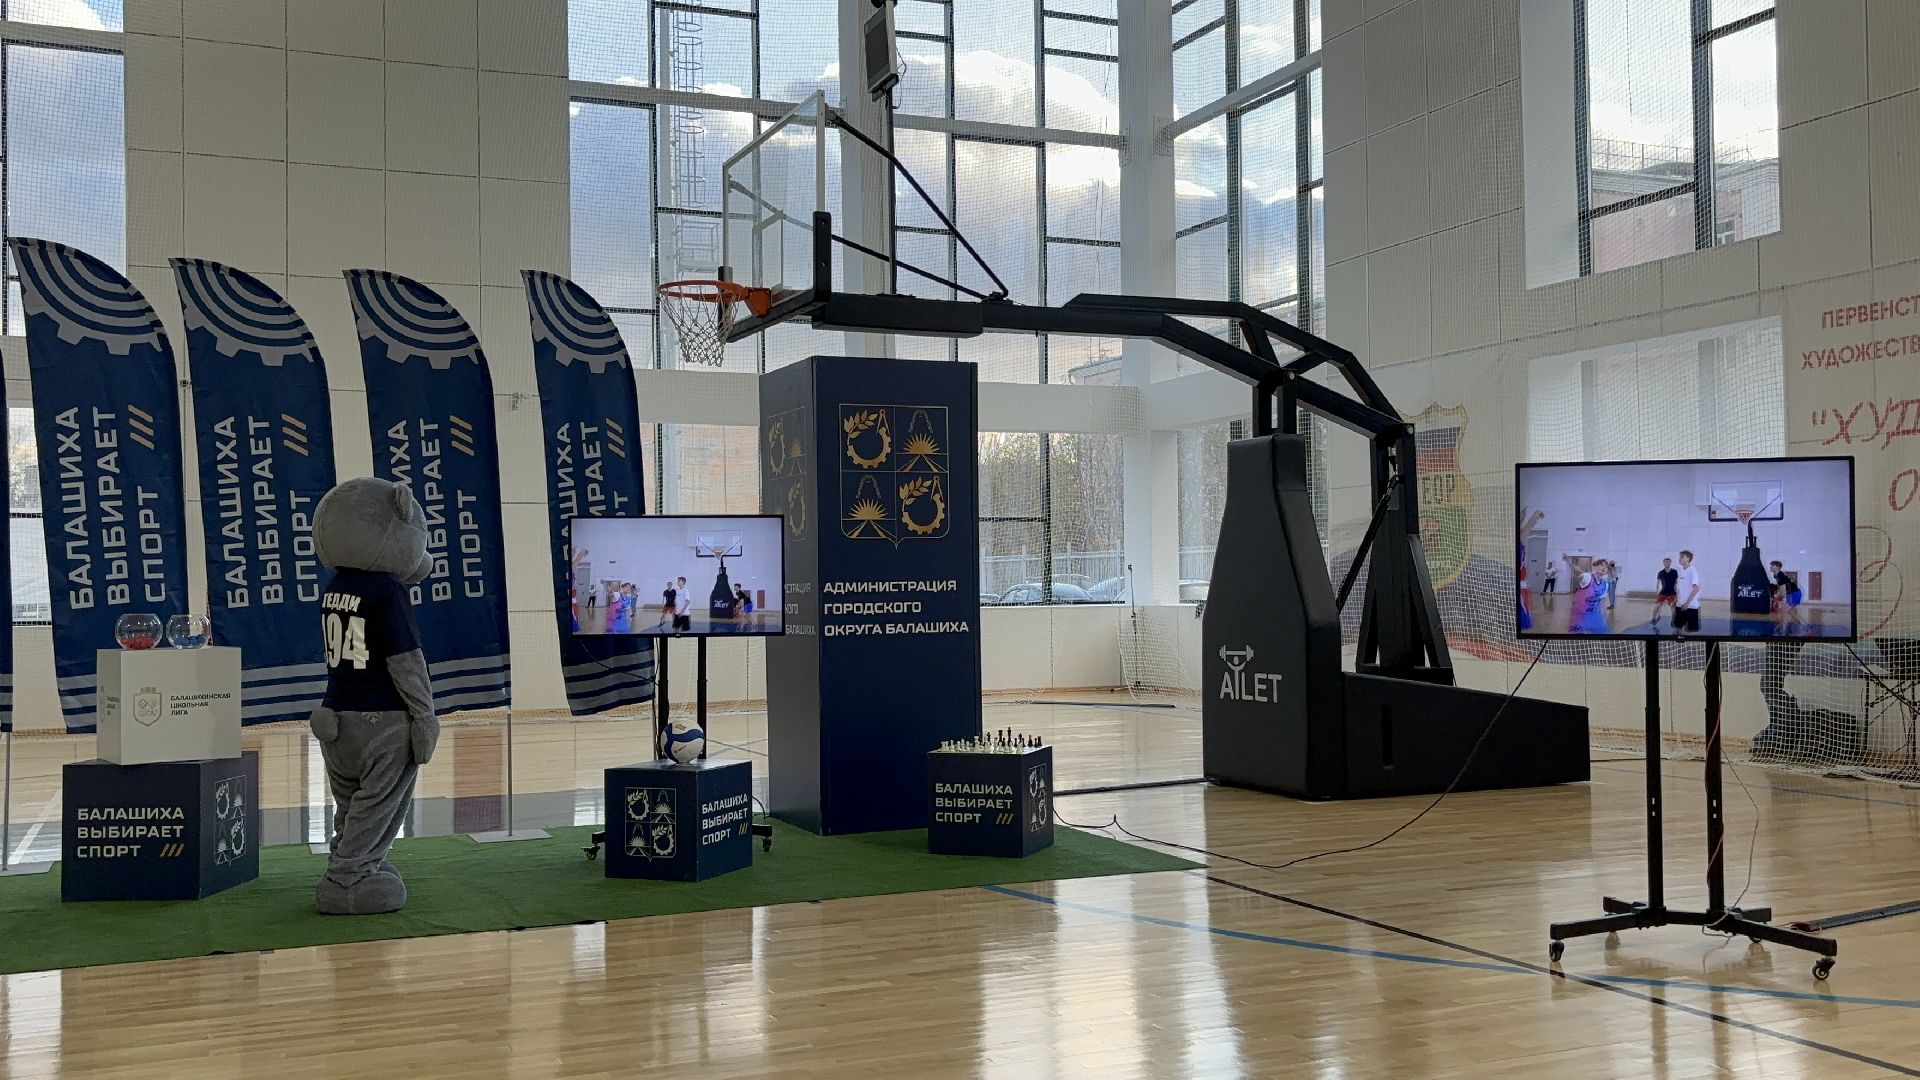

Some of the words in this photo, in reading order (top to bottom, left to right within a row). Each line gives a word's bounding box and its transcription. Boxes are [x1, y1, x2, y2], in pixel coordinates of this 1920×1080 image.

[1822, 295, 1920, 329] ПЕРВЕНСТ
[1801, 335, 1920, 369] ХУДОЖЕСТВ
[55, 406, 94, 609] БАЛАШИХА
[93, 406, 130, 605] ВЫБИРАЕТ
[214, 416, 249, 608] БАЛАШИХА
[248, 416, 283, 605] ВЫБИРАЕТ
[419, 418, 452, 602] ВЫБИРАЕТ
[137, 486, 166, 602] СПОРТ
[290, 490, 320, 602] СПОРТ
[457, 490, 485, 598] СПОРТ
[823, 580, 957, 595] АДМИНИСТРАЦИЯ
[824, 602, 922, 616] ГОРОДСКОГО
[824, 624, 883, 637] ОКРУГА
[886, 621, 969, 634] БАЛАШИХА
[170, 701, 209, 709] ШКОЛЬНАЯ
[170, 709, 189, 717] ЛИГА
[936, 783, 1013, 795] БАЛАШИХА
[702, 793, 748, 815] БАЛАШИХА
[936, 797, 1013, 809] ВЫБИРАЕТ
[77, 807, 185, 820] БАЛАШИХА
[702, 808, 748, 830] ВЫБИРАЕТ
[936, 812, 982, 824] СПОРТ
[77, 825, 185, 839] ВЫБИРАЕТ
[702, 828, 731, 846] СПОРТ
[77, 845, 142, 858] СПОРТ
